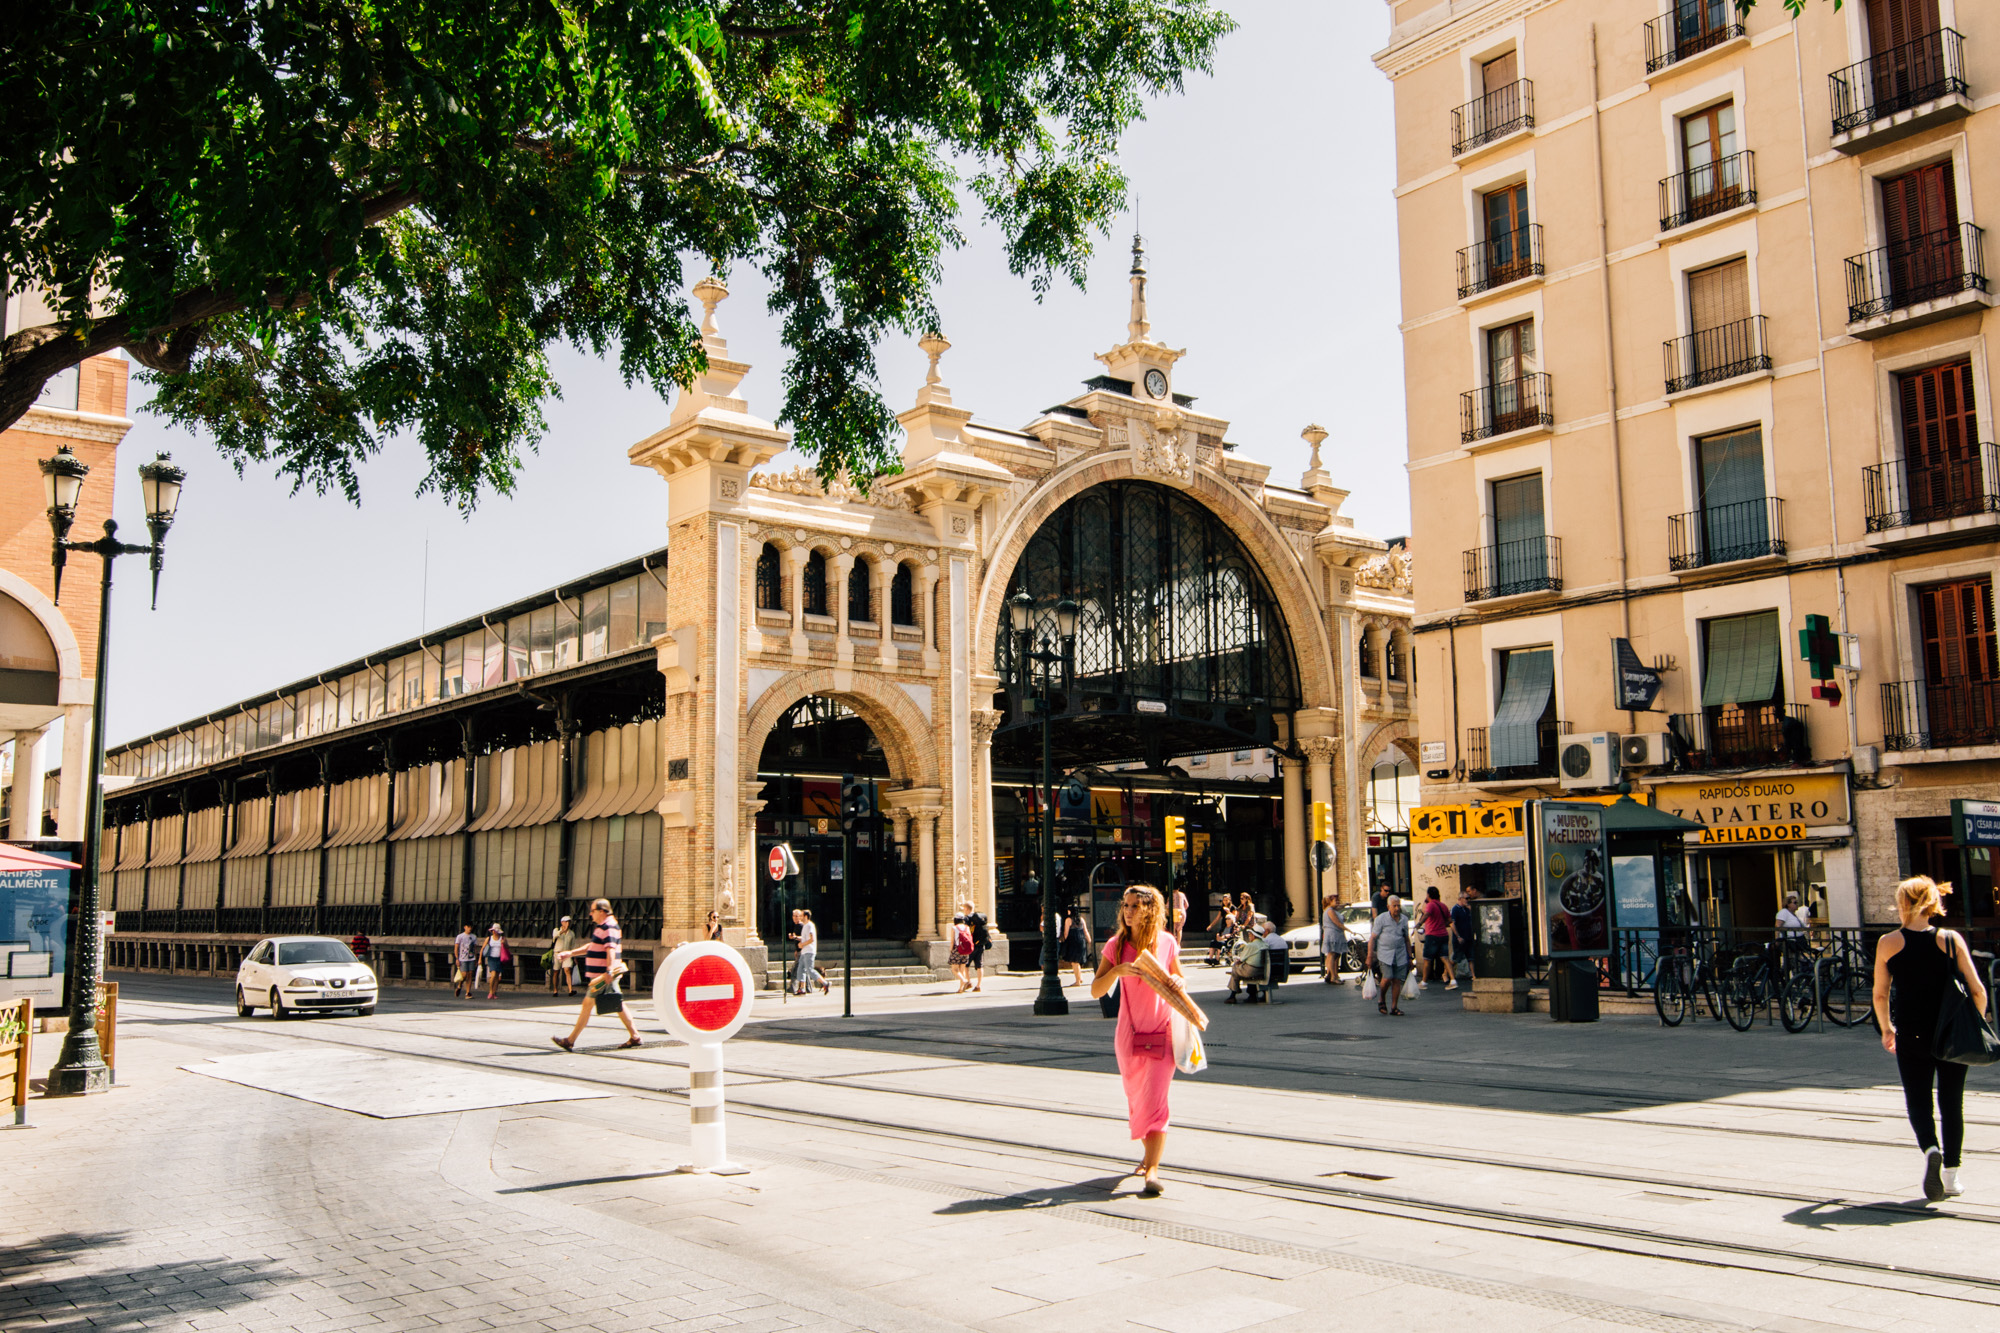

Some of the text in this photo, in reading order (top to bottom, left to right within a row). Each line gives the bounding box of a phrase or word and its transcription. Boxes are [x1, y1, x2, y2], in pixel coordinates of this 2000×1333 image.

[1699, 784, 1795, 800] RAPIDOS DUATO
[1556, 814, 1589, 828] NUEVO
[1965, 818, 1973, 840] P
[1548, 828, 1598, 844] McFLURRY
[1703, 825, 1803, 843] AFILADOR
